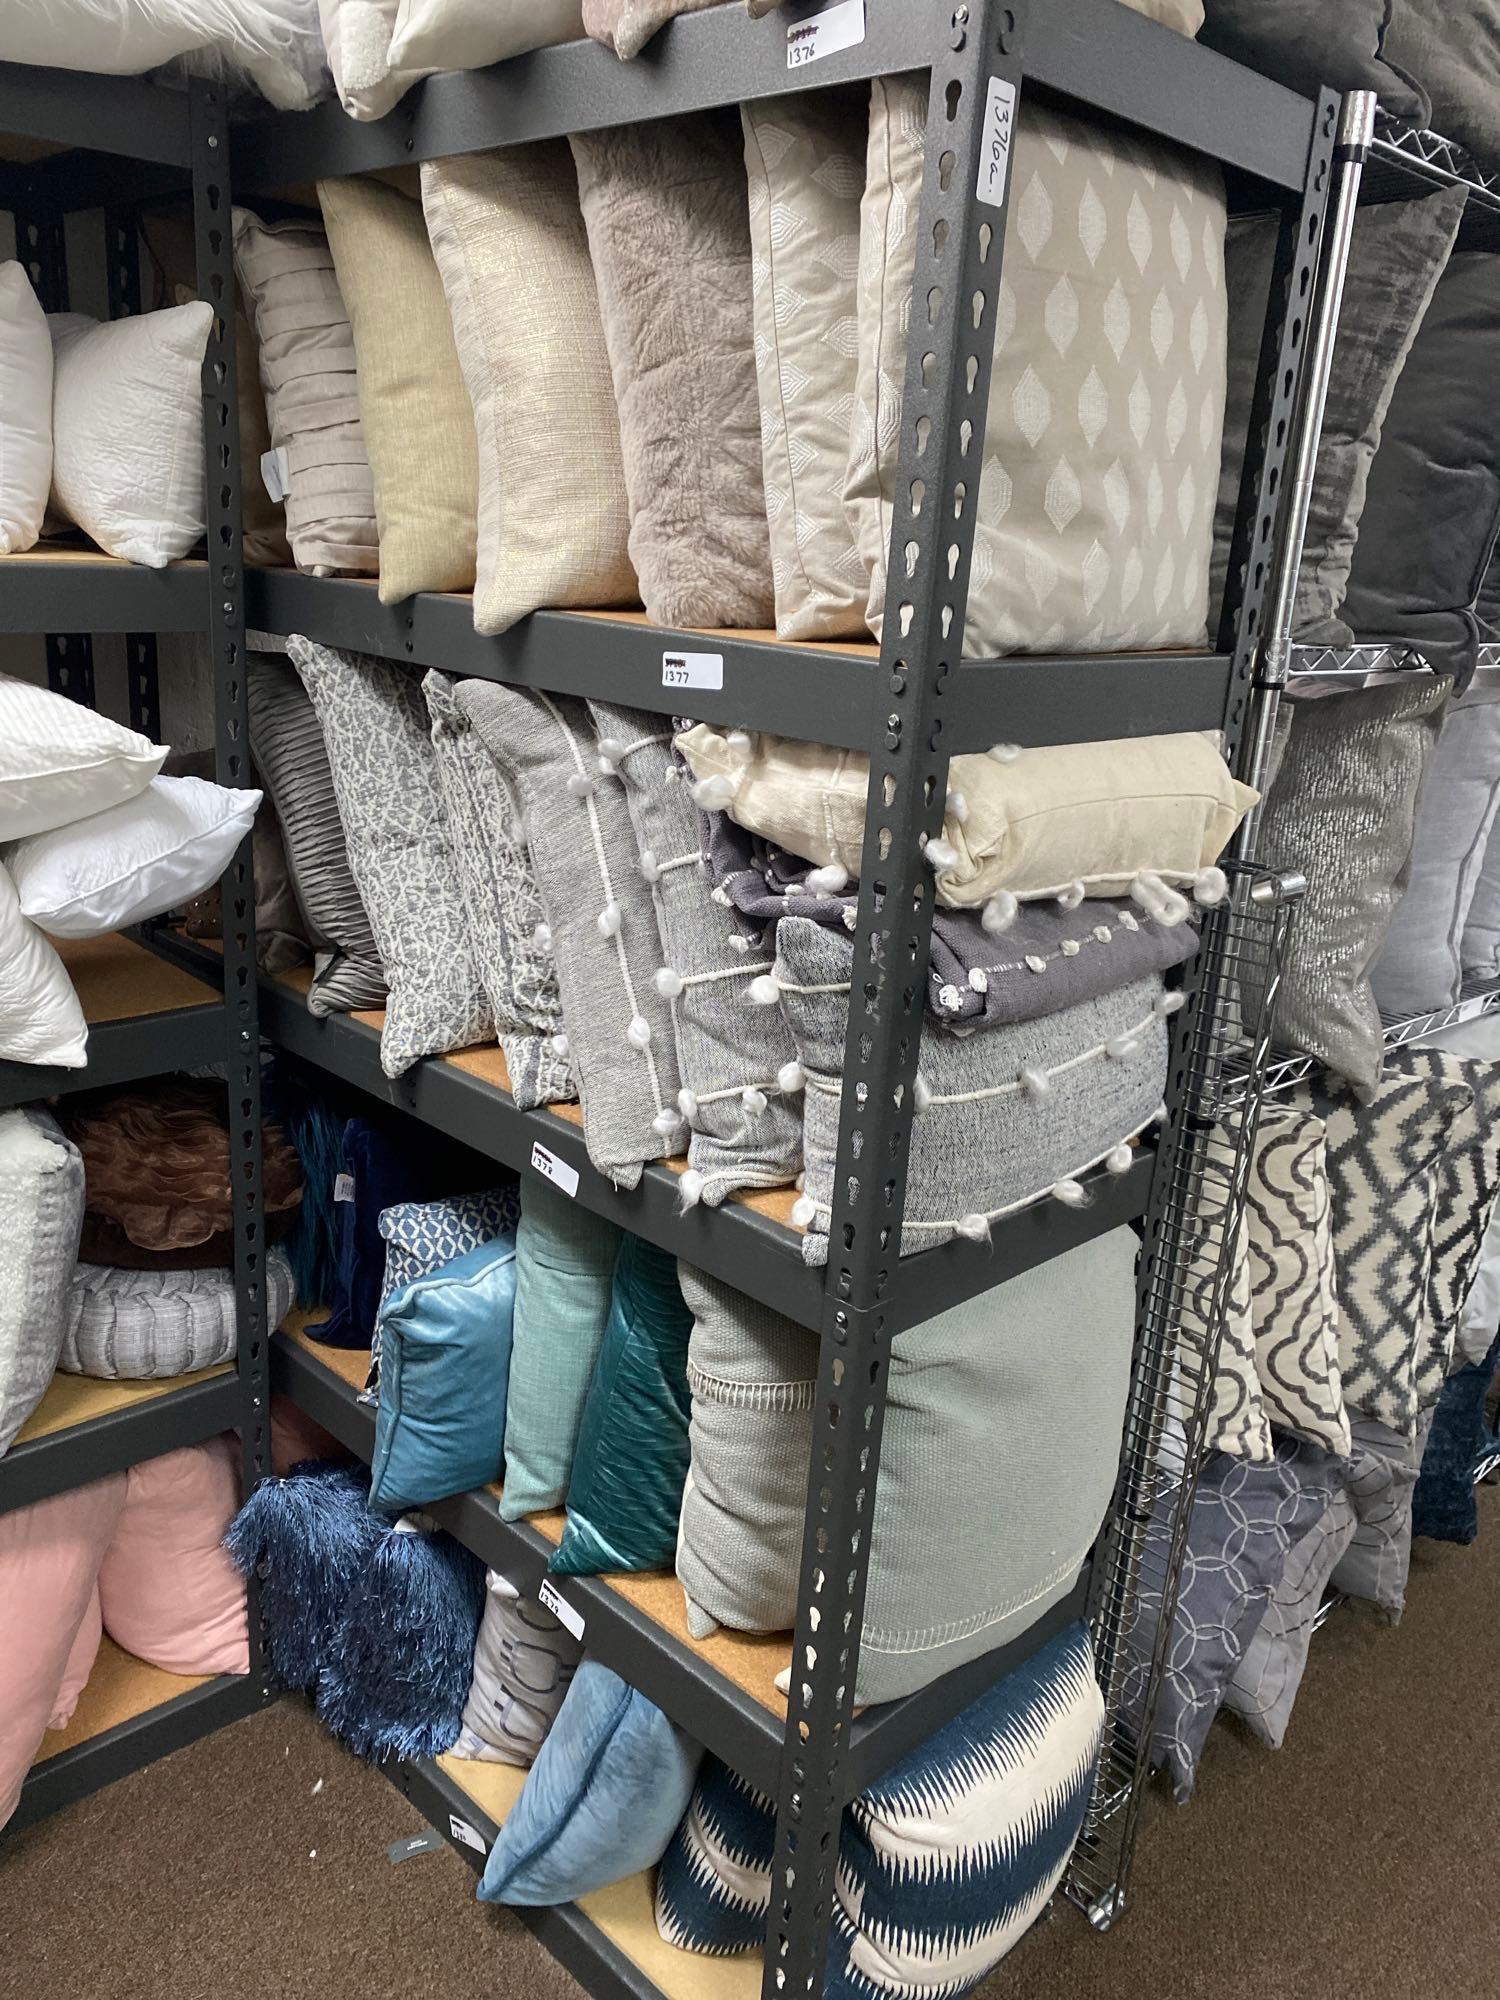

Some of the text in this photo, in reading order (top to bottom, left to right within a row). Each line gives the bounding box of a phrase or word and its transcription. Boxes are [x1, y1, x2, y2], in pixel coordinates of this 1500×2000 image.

[790, 42, 815, 65] 1376
[665, 670, 689, 684] 1377
[540, 1592, 559, 1615] 1379
